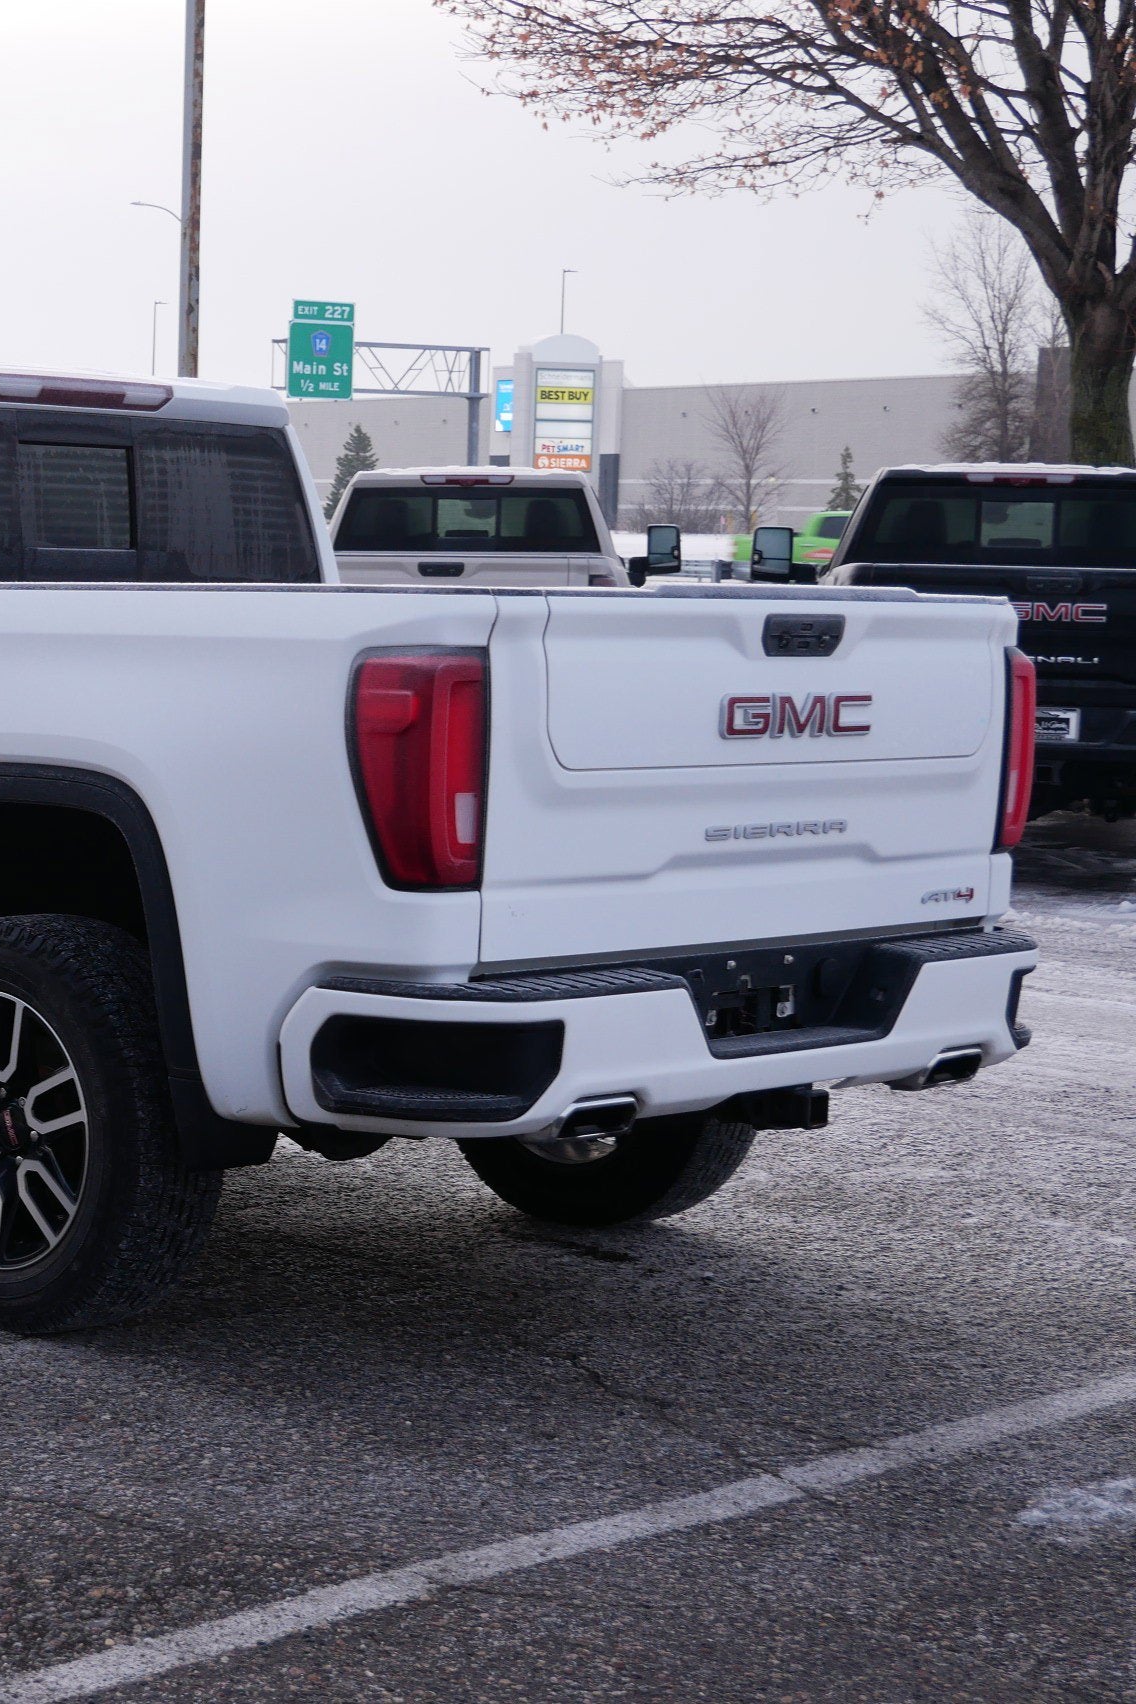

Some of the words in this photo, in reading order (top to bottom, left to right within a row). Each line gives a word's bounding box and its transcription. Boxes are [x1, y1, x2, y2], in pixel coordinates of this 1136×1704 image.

[297, 305, 318, 315] EXIT
[324, 306, 350, 319] 227
[315, 338, 327, 351] 14
[292, 361, 326, 375] Main
[333, 362, 349, 376] St
[319, 382, 340, 391] MILE
[540, 390, 566, 400] BEST
[568, 391, 590, 401] BUY
[549, 457, 588, 468] SIERRA
[718, 691, 872, 740] GMC
[705, 819, 847, 841] SIERRA
[921, 887, 974, 904] AT4
